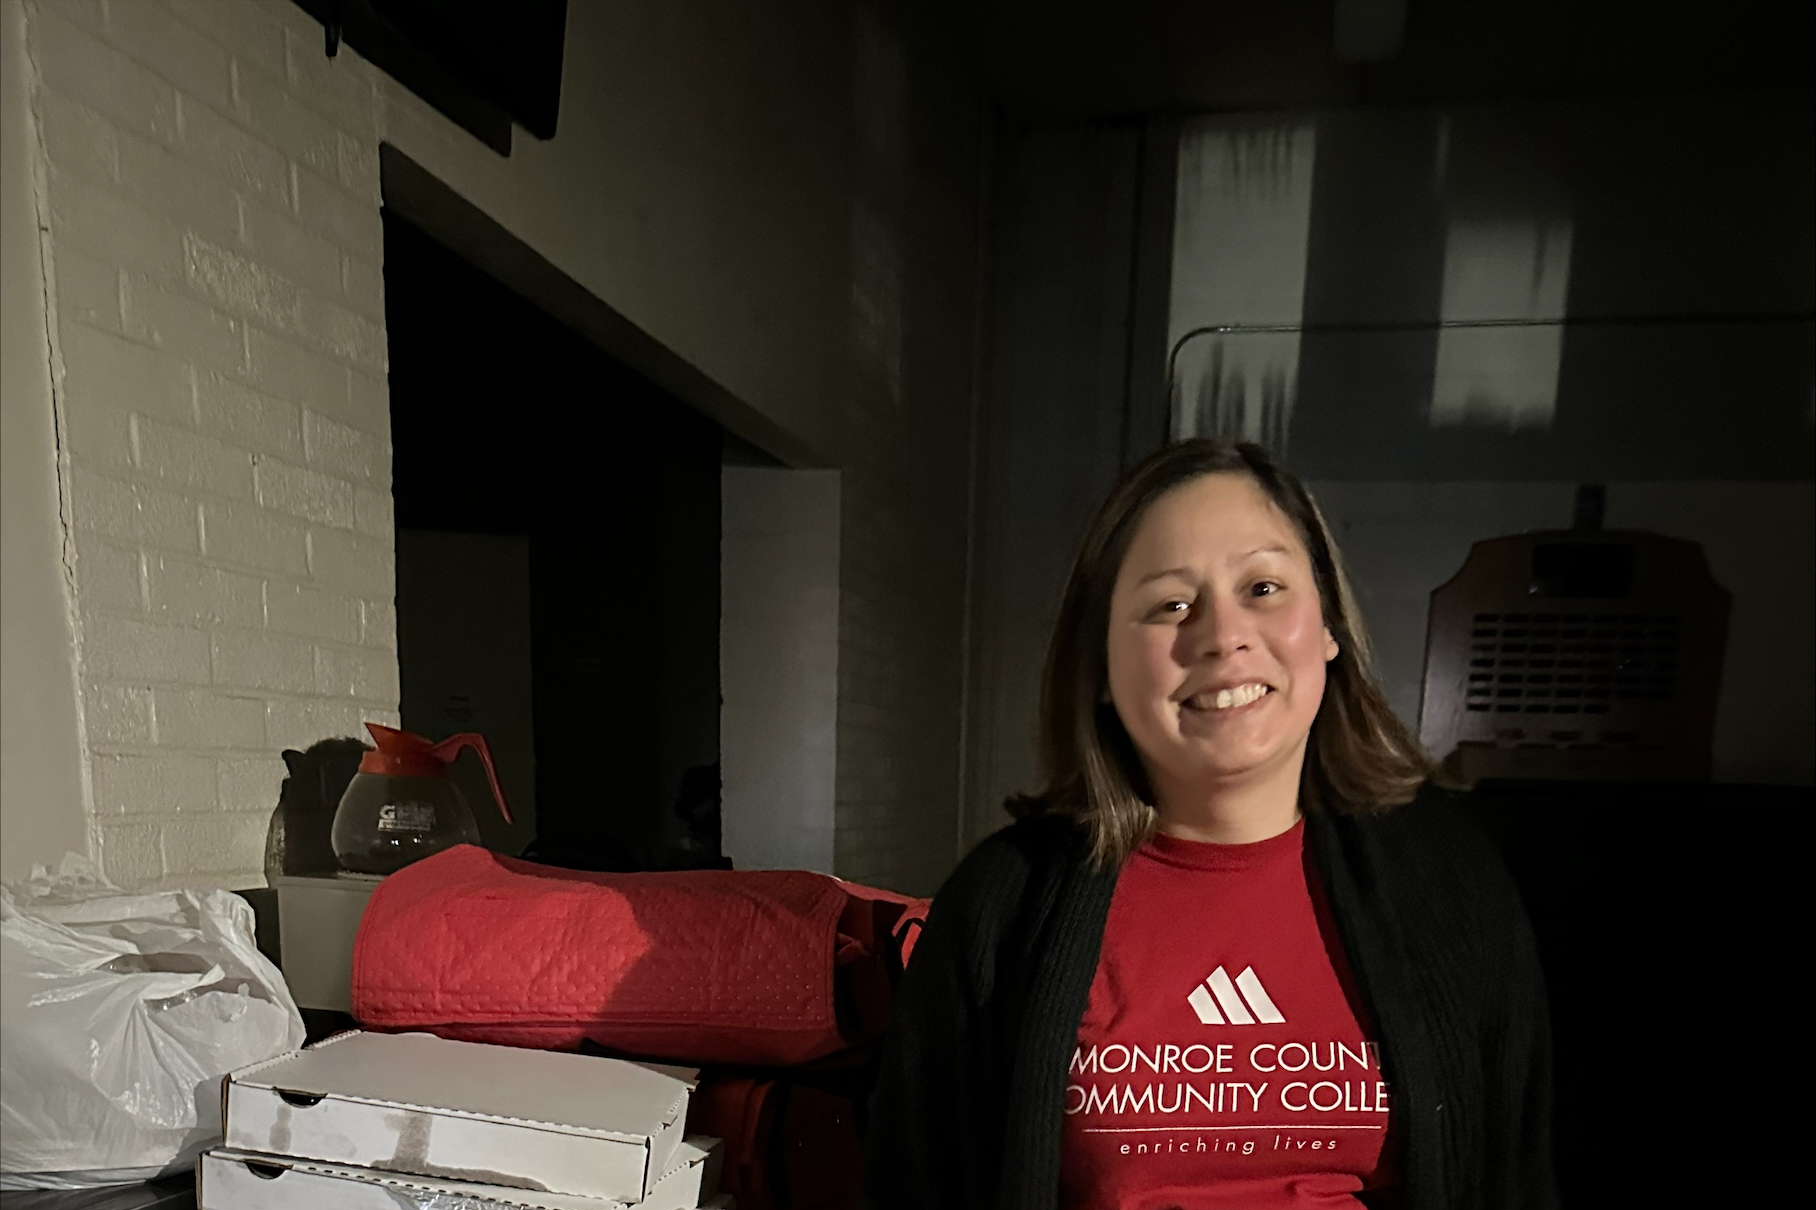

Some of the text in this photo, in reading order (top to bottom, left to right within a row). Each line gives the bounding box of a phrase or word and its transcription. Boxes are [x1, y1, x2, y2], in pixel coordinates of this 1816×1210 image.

[1067, 1043, 1234, 1075] MONROE
[1280, 1080, 1391, 1113] COLLE
[1119, 1134, 1338, 1155] enriching lives
